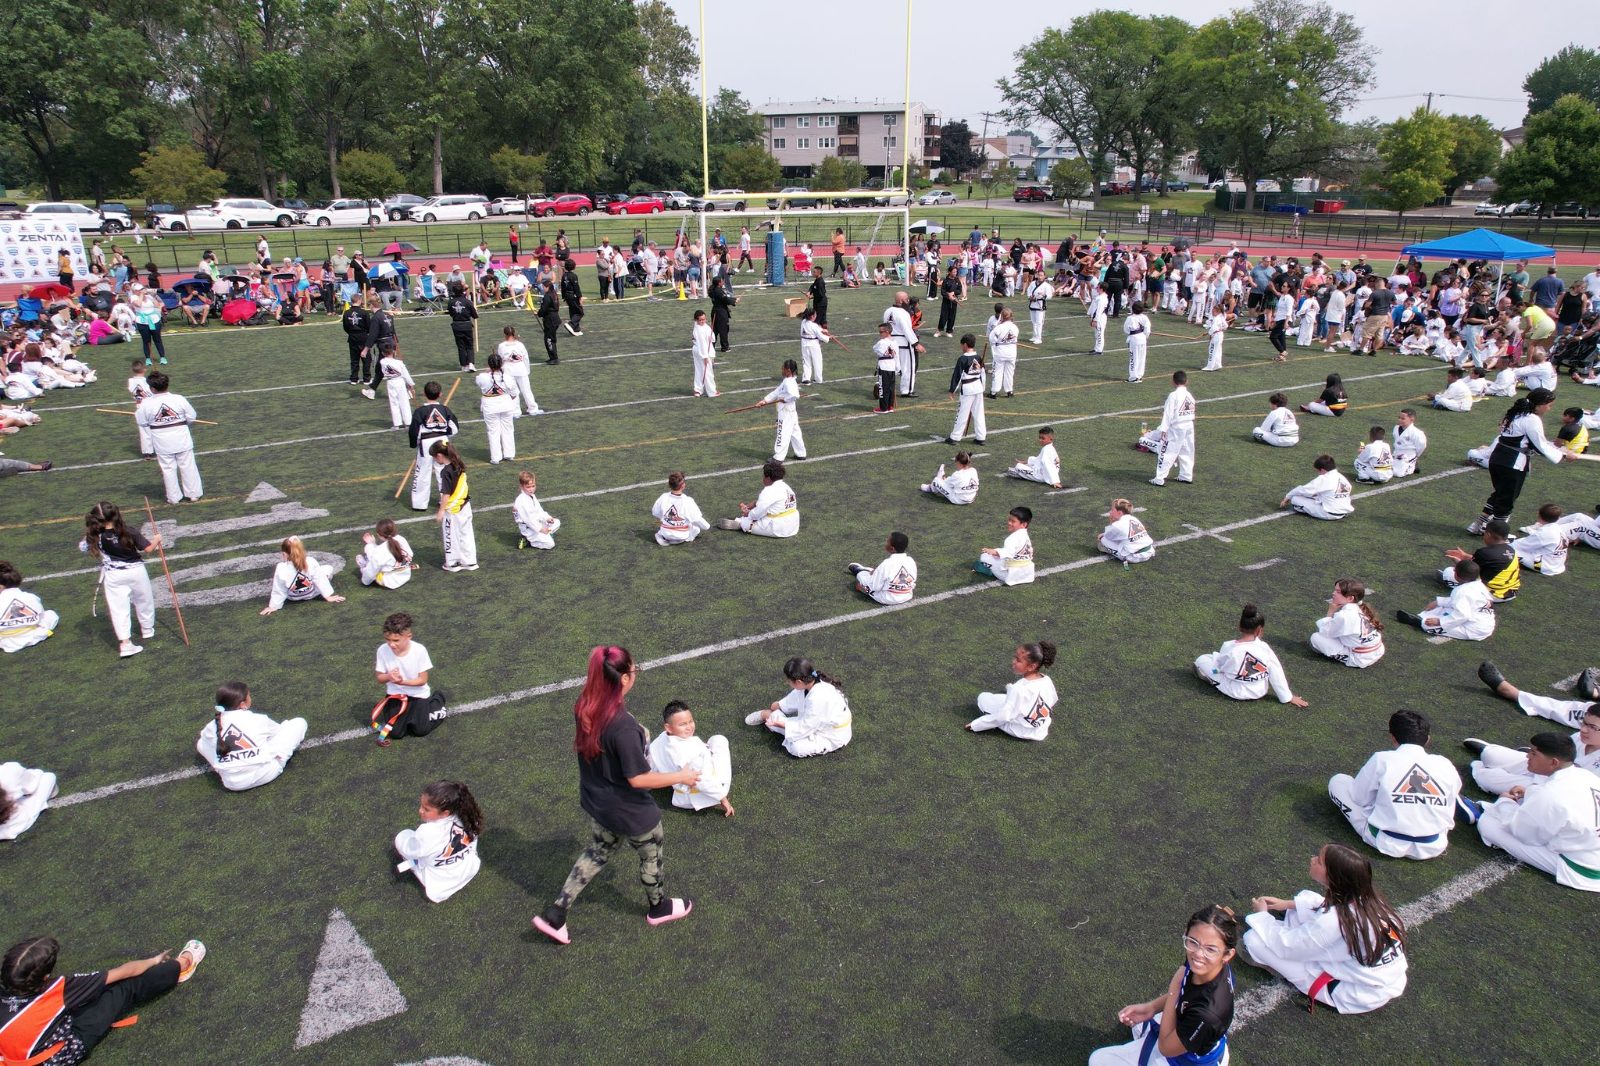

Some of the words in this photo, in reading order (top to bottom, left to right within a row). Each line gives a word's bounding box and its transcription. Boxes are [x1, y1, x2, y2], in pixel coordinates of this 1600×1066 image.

[18, 234, 67, 242] ZENTAI
[776, 419, 784, 447] ZENTAI
[1158, 440, 1169, 469] ZENTAI
[412, 465, 421, 493] ZENTAI
[1392, 794, 1447, 807] ZENTAI
